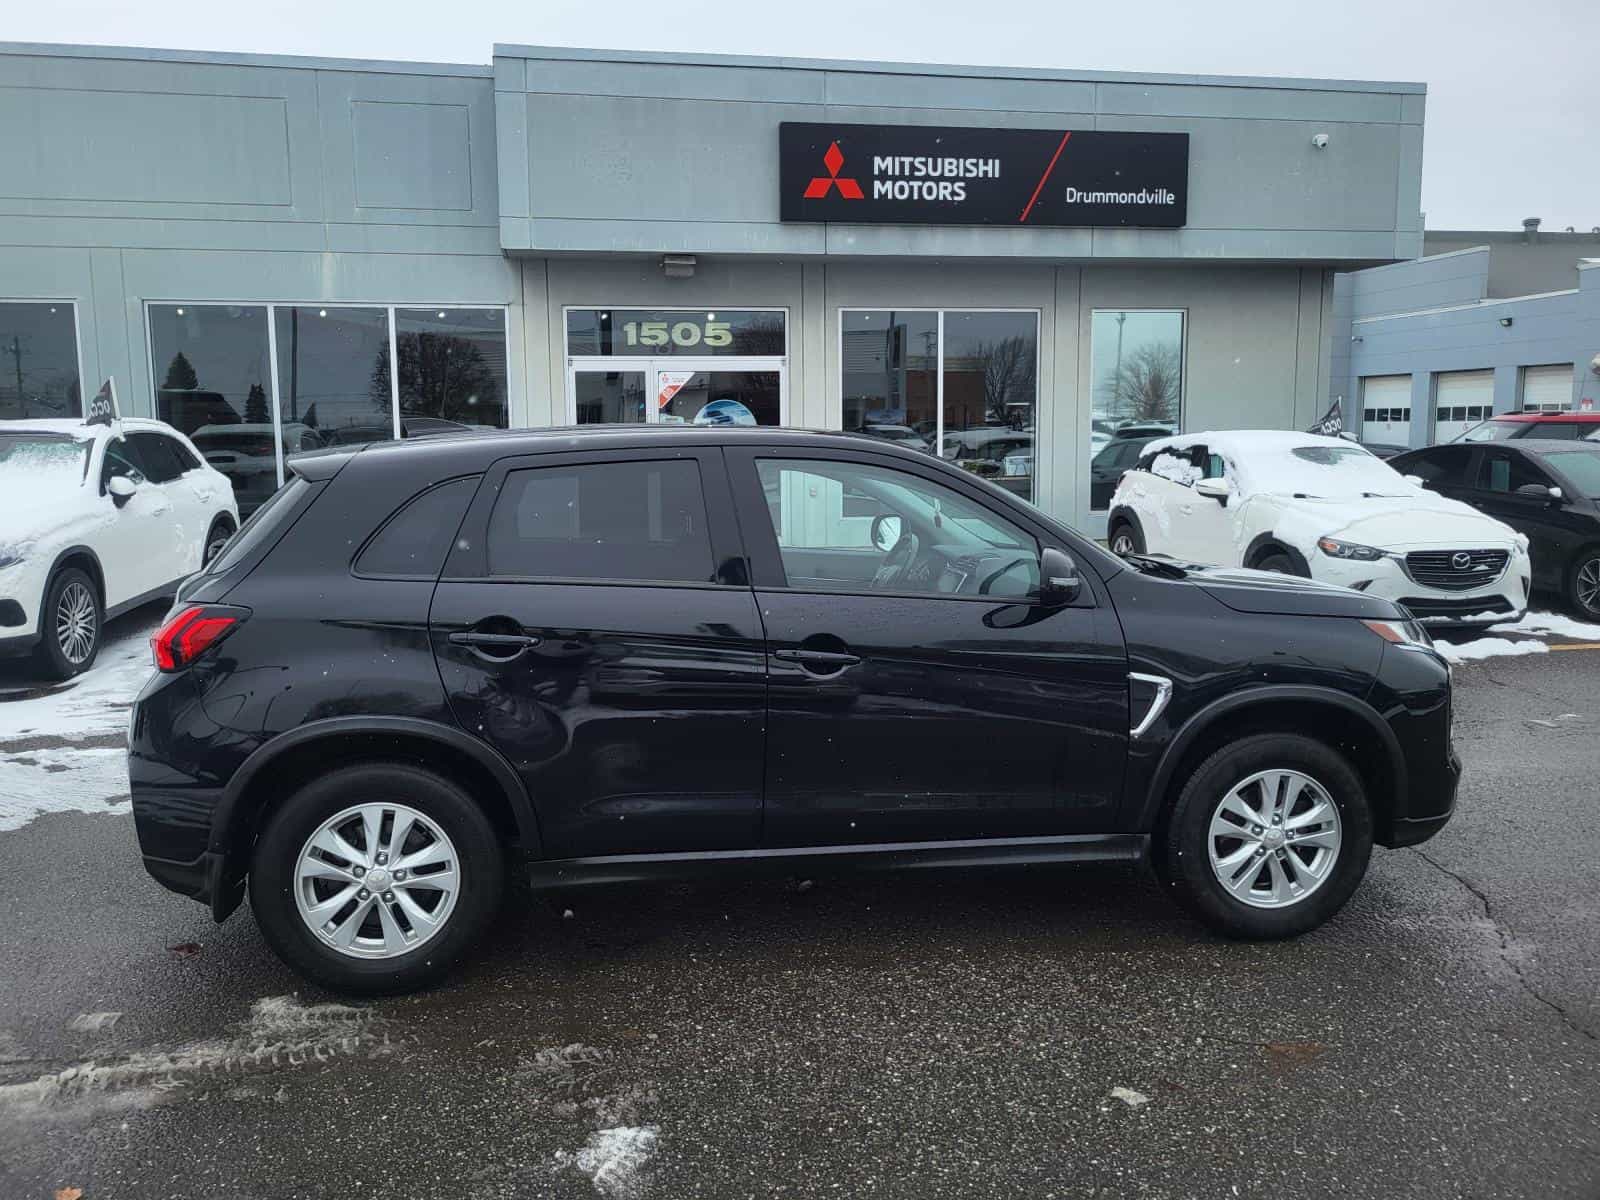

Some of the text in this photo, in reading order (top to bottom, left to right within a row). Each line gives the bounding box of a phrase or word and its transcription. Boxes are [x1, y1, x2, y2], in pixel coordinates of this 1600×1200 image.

[873, 156, 1000, 178] MITSUBISHI
[873, 180, 966, 201] MOTORS
[1066, 187, 1175, 205] Drummondville
[623, 321, 733, 346] 1505
